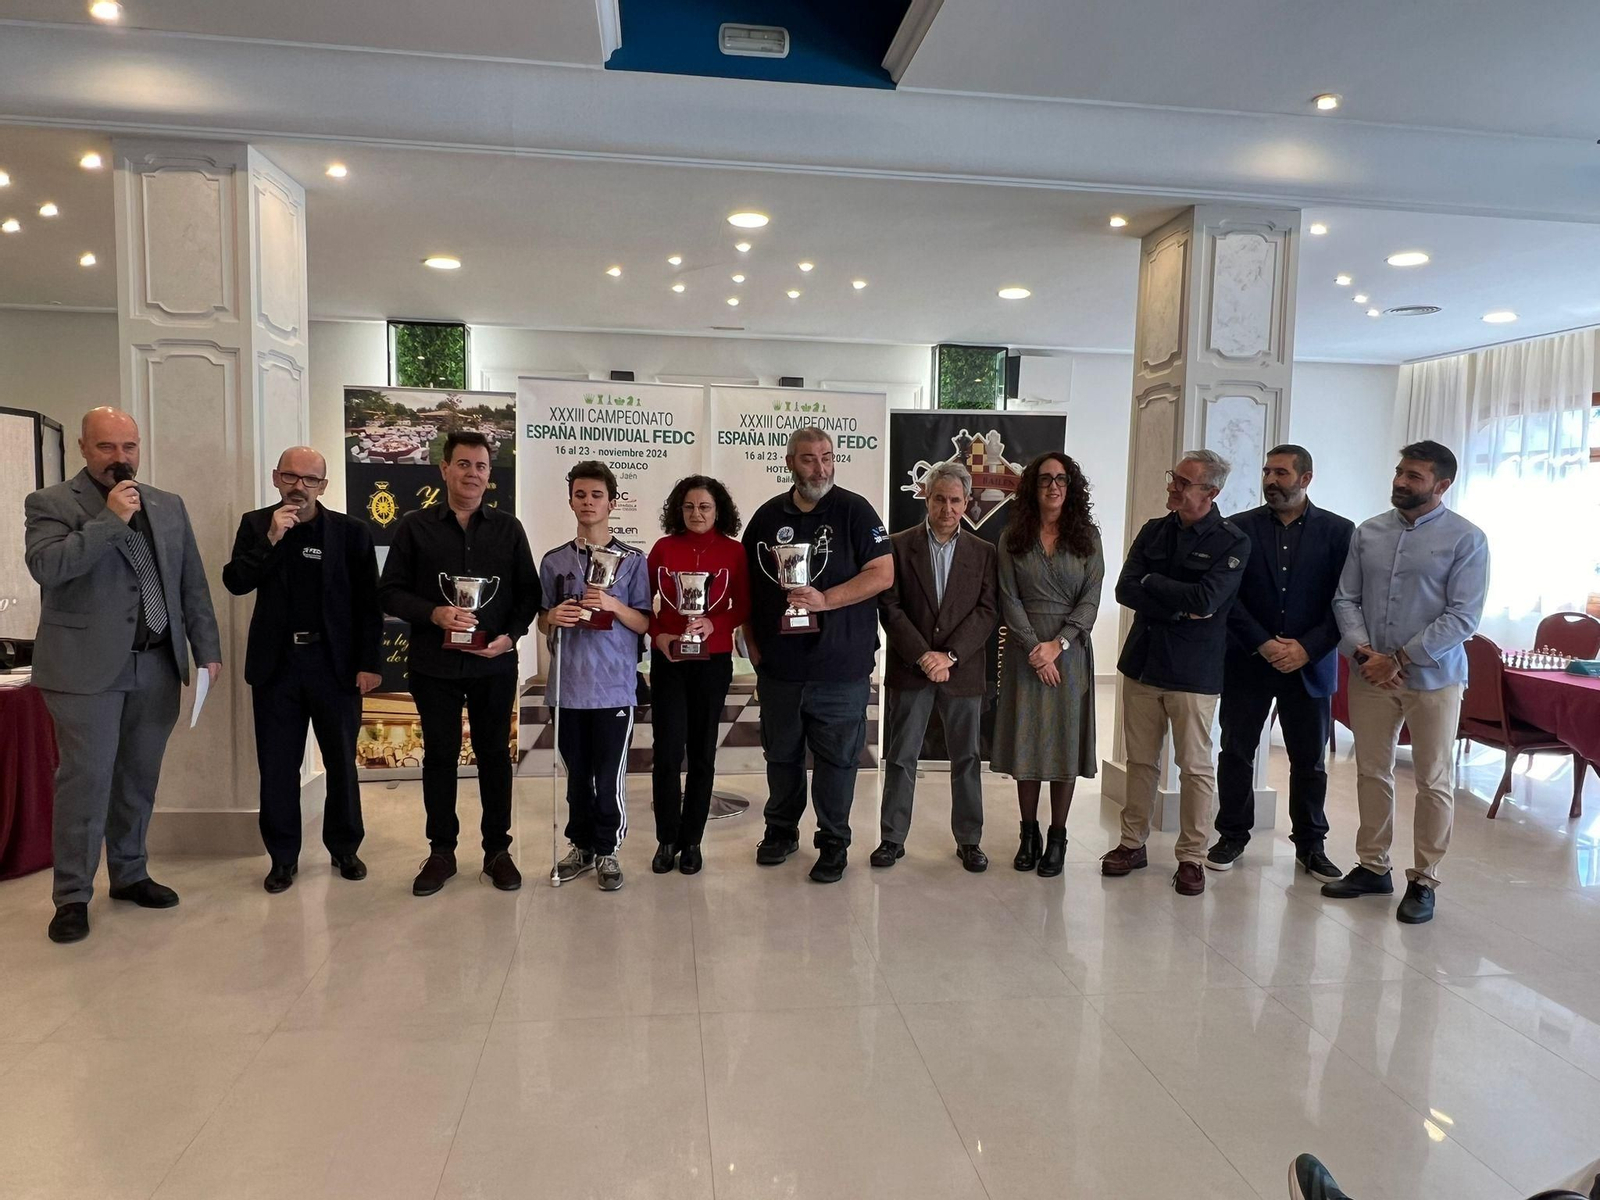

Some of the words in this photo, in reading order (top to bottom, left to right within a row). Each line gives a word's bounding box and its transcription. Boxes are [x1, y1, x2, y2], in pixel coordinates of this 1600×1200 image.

[550, 407, 585, 423] XXXIII
[588, 408, 673, 427] CAMPEONATO
[739, 414, 773, 429] XXXIII
[776, 415, 857, 432] CAMPEONATO
[526, 422, 577, 441] ESPAÑA
[580, 426, 650, 443] INDIVIDUAL
[652, 430, 695, 445] FEDC
[718, 428, 765, 446] ESPAÑA
[837, 435, 878, 449] FEDC
[555, 446, 566, 455] 16
[568, 446, 577, 456] al
[578, 447, 590, 456] 23
[598, 448, 644, 458] noviembre
[646, 449, 668, 459] 2024
[745, 451, 755, 460] 16
[757, 452, 765, 461] al
[767, 452, 778, 461] 23
[609, 461, 648, 470] ZODIACO
[766, 465, 792, 473] HOTE
[620, 472, 638, 480] Jaén
